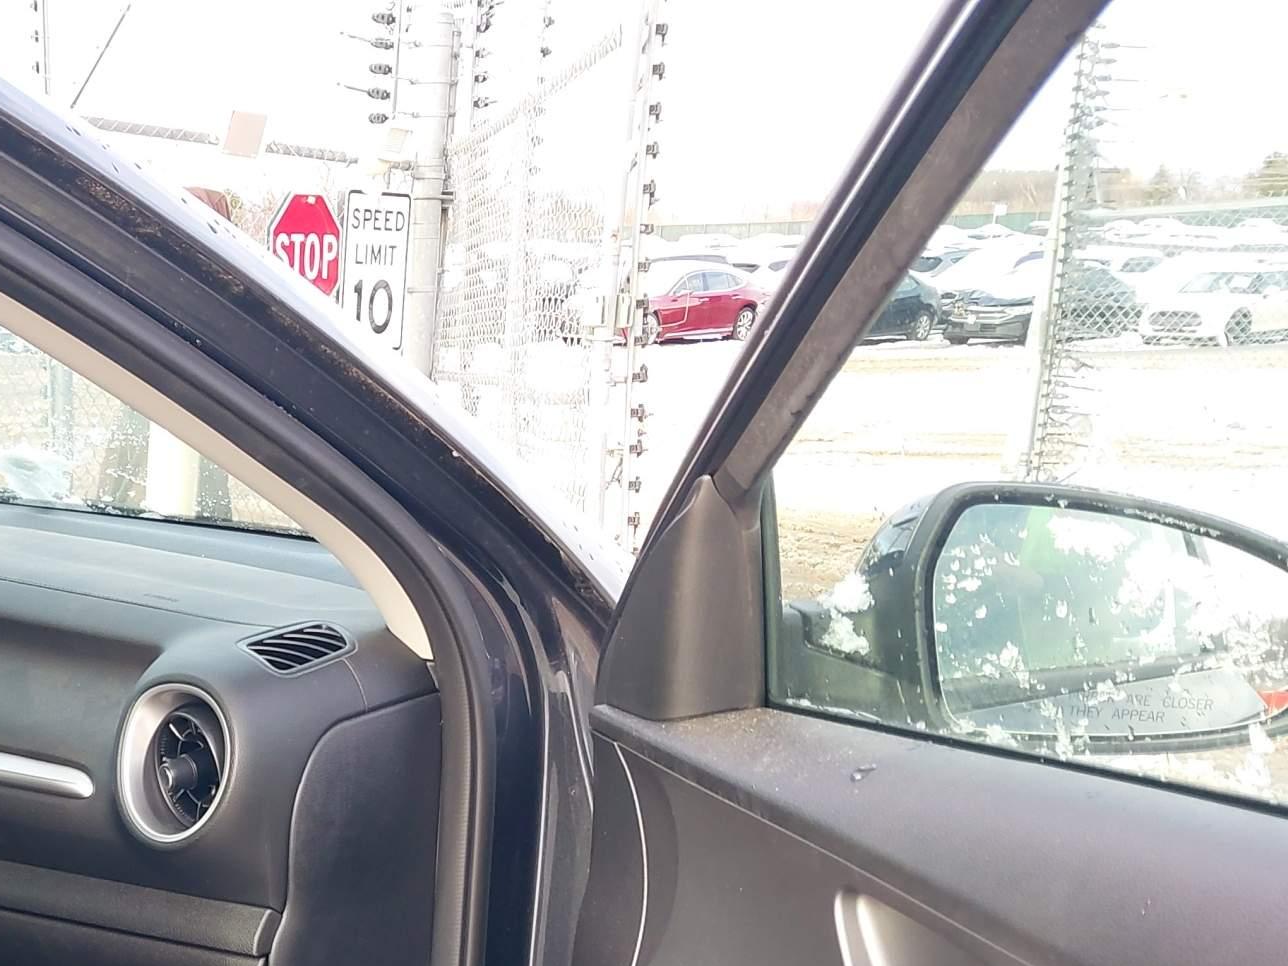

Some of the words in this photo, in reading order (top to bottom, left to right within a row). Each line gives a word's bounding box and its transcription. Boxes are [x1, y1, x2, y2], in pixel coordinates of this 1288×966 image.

[352, 208, 405, 232] SPEED
[275, 232, 338, 281] STOP
[355, 245, 397, 266] LIMIT
[353, 279, 393, 335] 10
[1127, 693, 1152, 707] ARE
[1162, 695, 1215, 712] CLOSER
[1111, 707, 1166, 723] APPEAR
